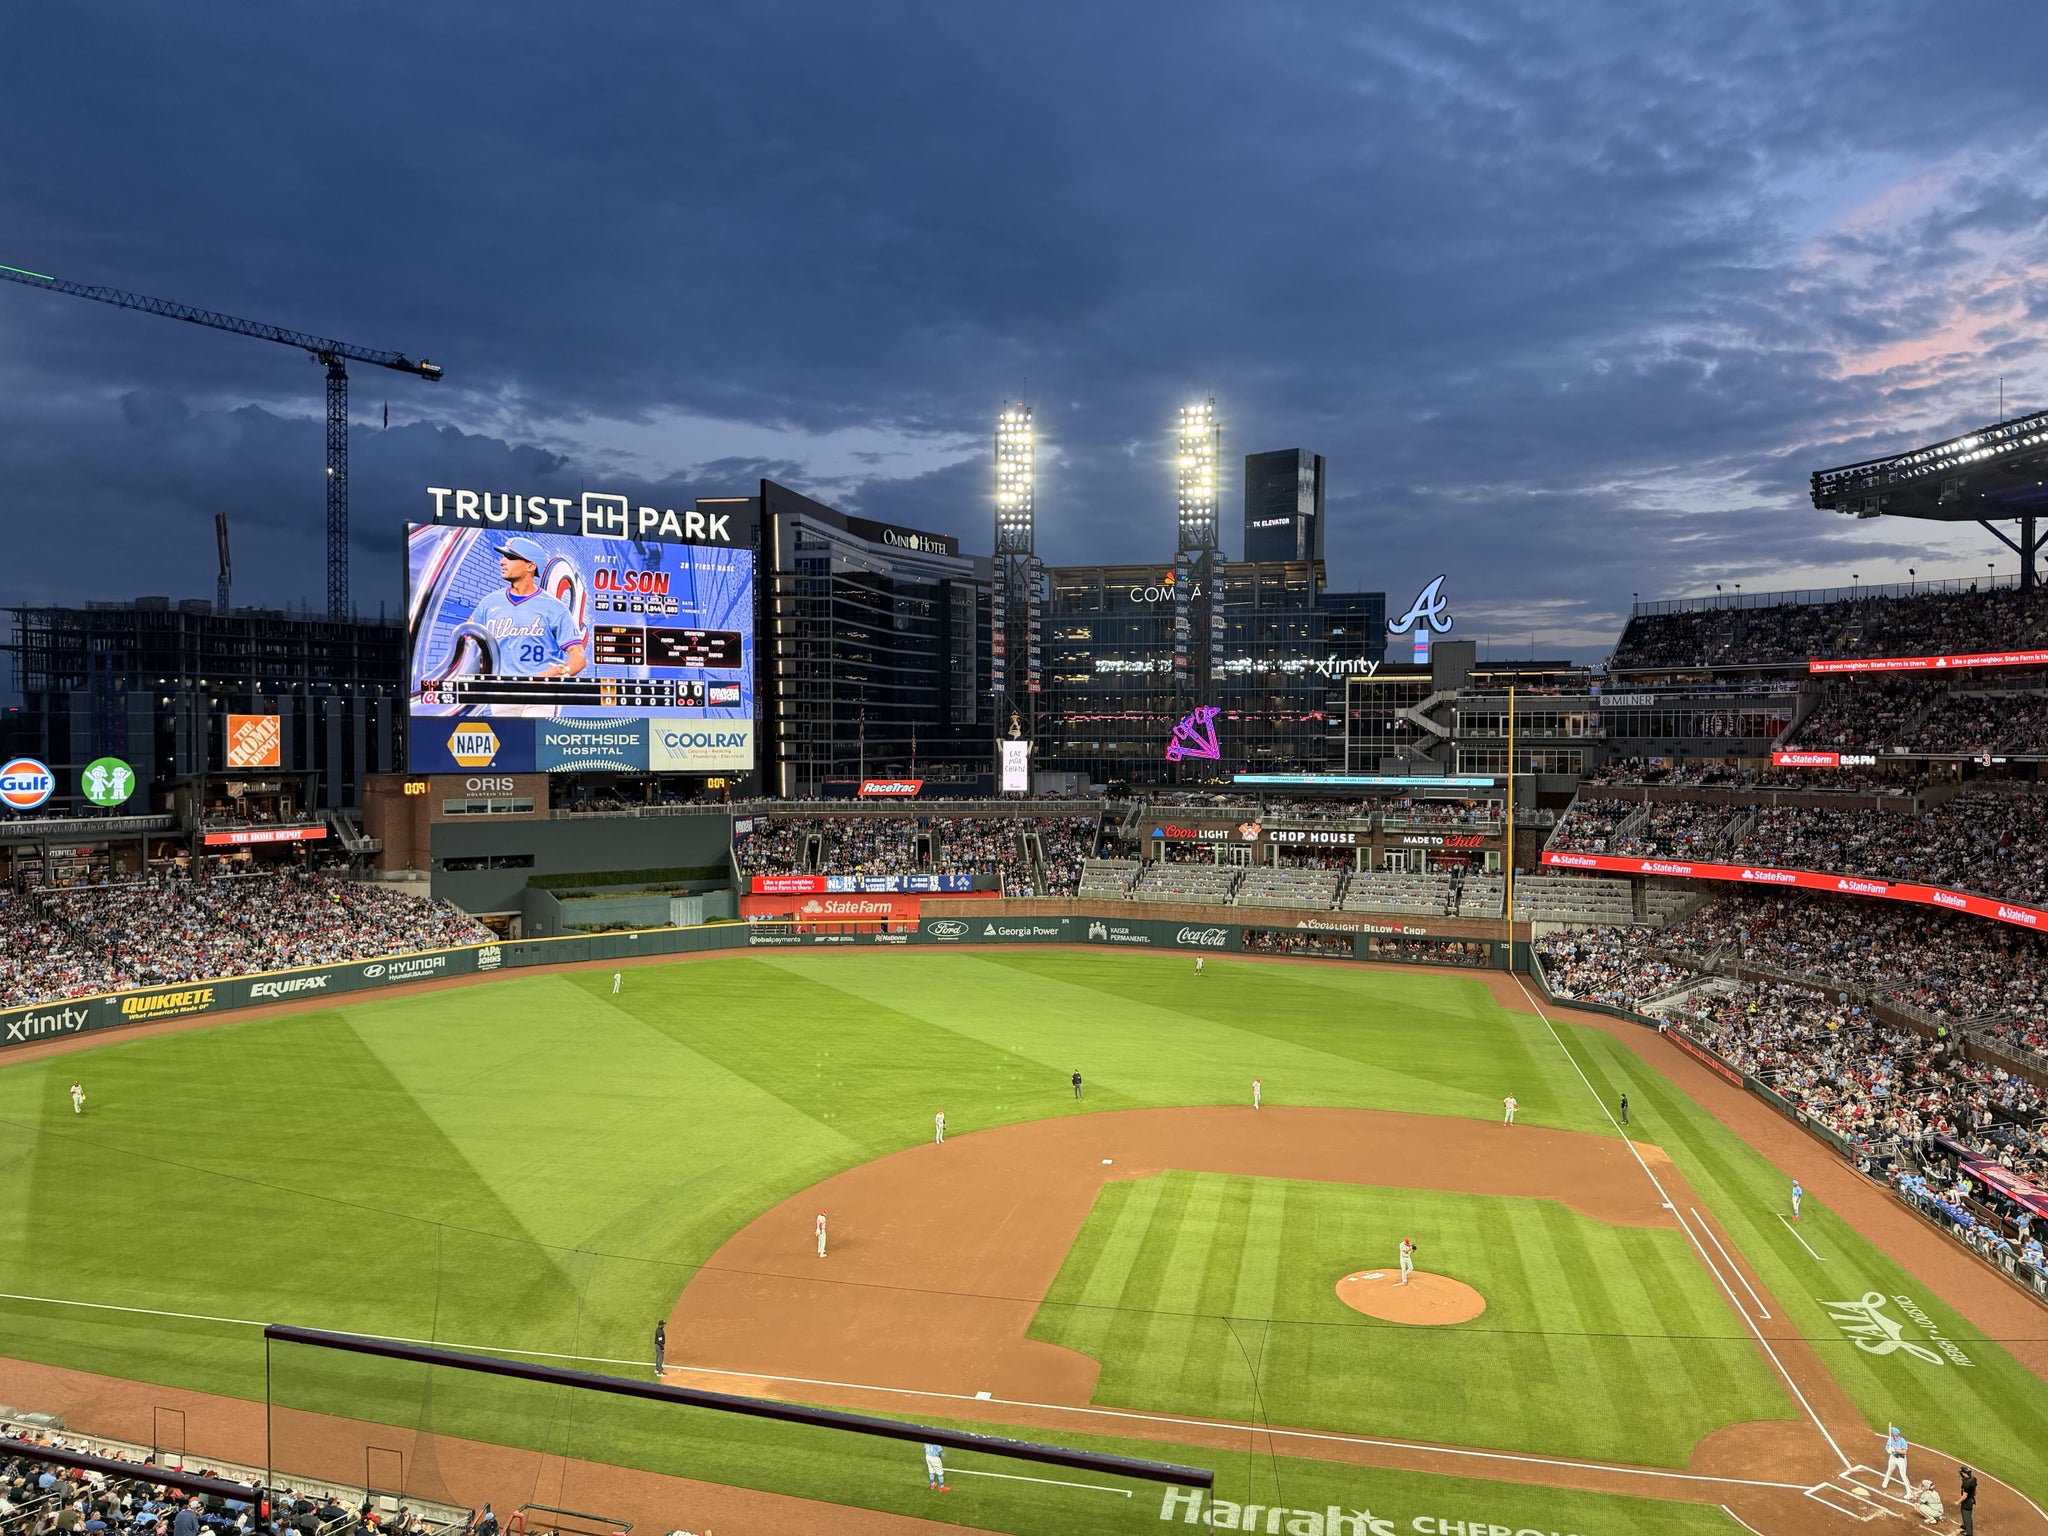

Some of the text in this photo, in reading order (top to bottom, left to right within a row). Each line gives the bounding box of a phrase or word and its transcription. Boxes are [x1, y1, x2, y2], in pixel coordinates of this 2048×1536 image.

[427, 487, 730, 541] TRUIST PARK
[1261, 517, 1290, 527] ELEVATOR
[594, 555, 617, 564] MATT
[680, 562, 735, 572] 28 FIRST BASE
[593, 567, 670, 595] OLSON
[484, 615, 546, 640] Atlanta
[520, 644, 545, 662] 28
[1315, 655, 1380, 678] xfinity
[463, 682, 469, 691] 1
[606, 686, 670, 696] 1 1 0 1 2
[678, 684, 702, 697] 0 0
[606, 697, 670, 706] 0 0 0 0 2
[1612, 695, 1652, 706] MILNER
[233, 721, 256, 741] THE
[229, 716, 281, 766] HOME
[456, 735, 491, 754] NAPA
[545, 734, 640, 746] NORTHSIDE
[664, 732, 748, 748] COOLRAY
[249, 733, 281, 766] DEPOT
[562, 747, 623, 756] HOSPITAL
[1840, 755, 1860, 765] 8:24
[1860, 756, 1876, 765] PM
[1982, 754, 1990, 766] 3
[0, 776, 49, 791] Gulf
[404, 782, 426, 795] 0:09
[465, 778, 514, 791] ORIS
[708, 777, 725, 789] 0:09
[863, 782, 916, 793] RaceTrac
[231, 830, 302, 843] THE HOME DEPOT
[1165, 825, 1230, 840] Coors LIGHT
[1270, 831, 1356, 844] CHOP HOUSE
[1403, 834, 1484, 848] MADE TO Chill
[828, 880, 842, 889] NL
[934, 922, 962, 934] Ford
[998, 926, 1059, 938] Georgia Power
[1308, 919, 1427, 936] Coors LIGHT BELOW CHOP
[1110, 934, 1148, 943] PERMANENTE
[1176, 926, 1229, 946] Coca-Cola
[478, 946, 501, 958] PAPA
[388, 956, 446, 974] HYUNDAI
[477, 956, 502, 966] JOHNS
[388, 970, 434, 981] HyundaiUSA.com
[250, 975, 328, 998] EQUIFAX
[105, 996, 116, 1005] 385
[121, 988, 214, 1014] QUIKRETE
[128, 1010, 148, 1021] What
[148, 1006, 179, 1018] America's
[180, 1004, 197, 1014] Made
[6, 1007, 89, 1041] xfinity
